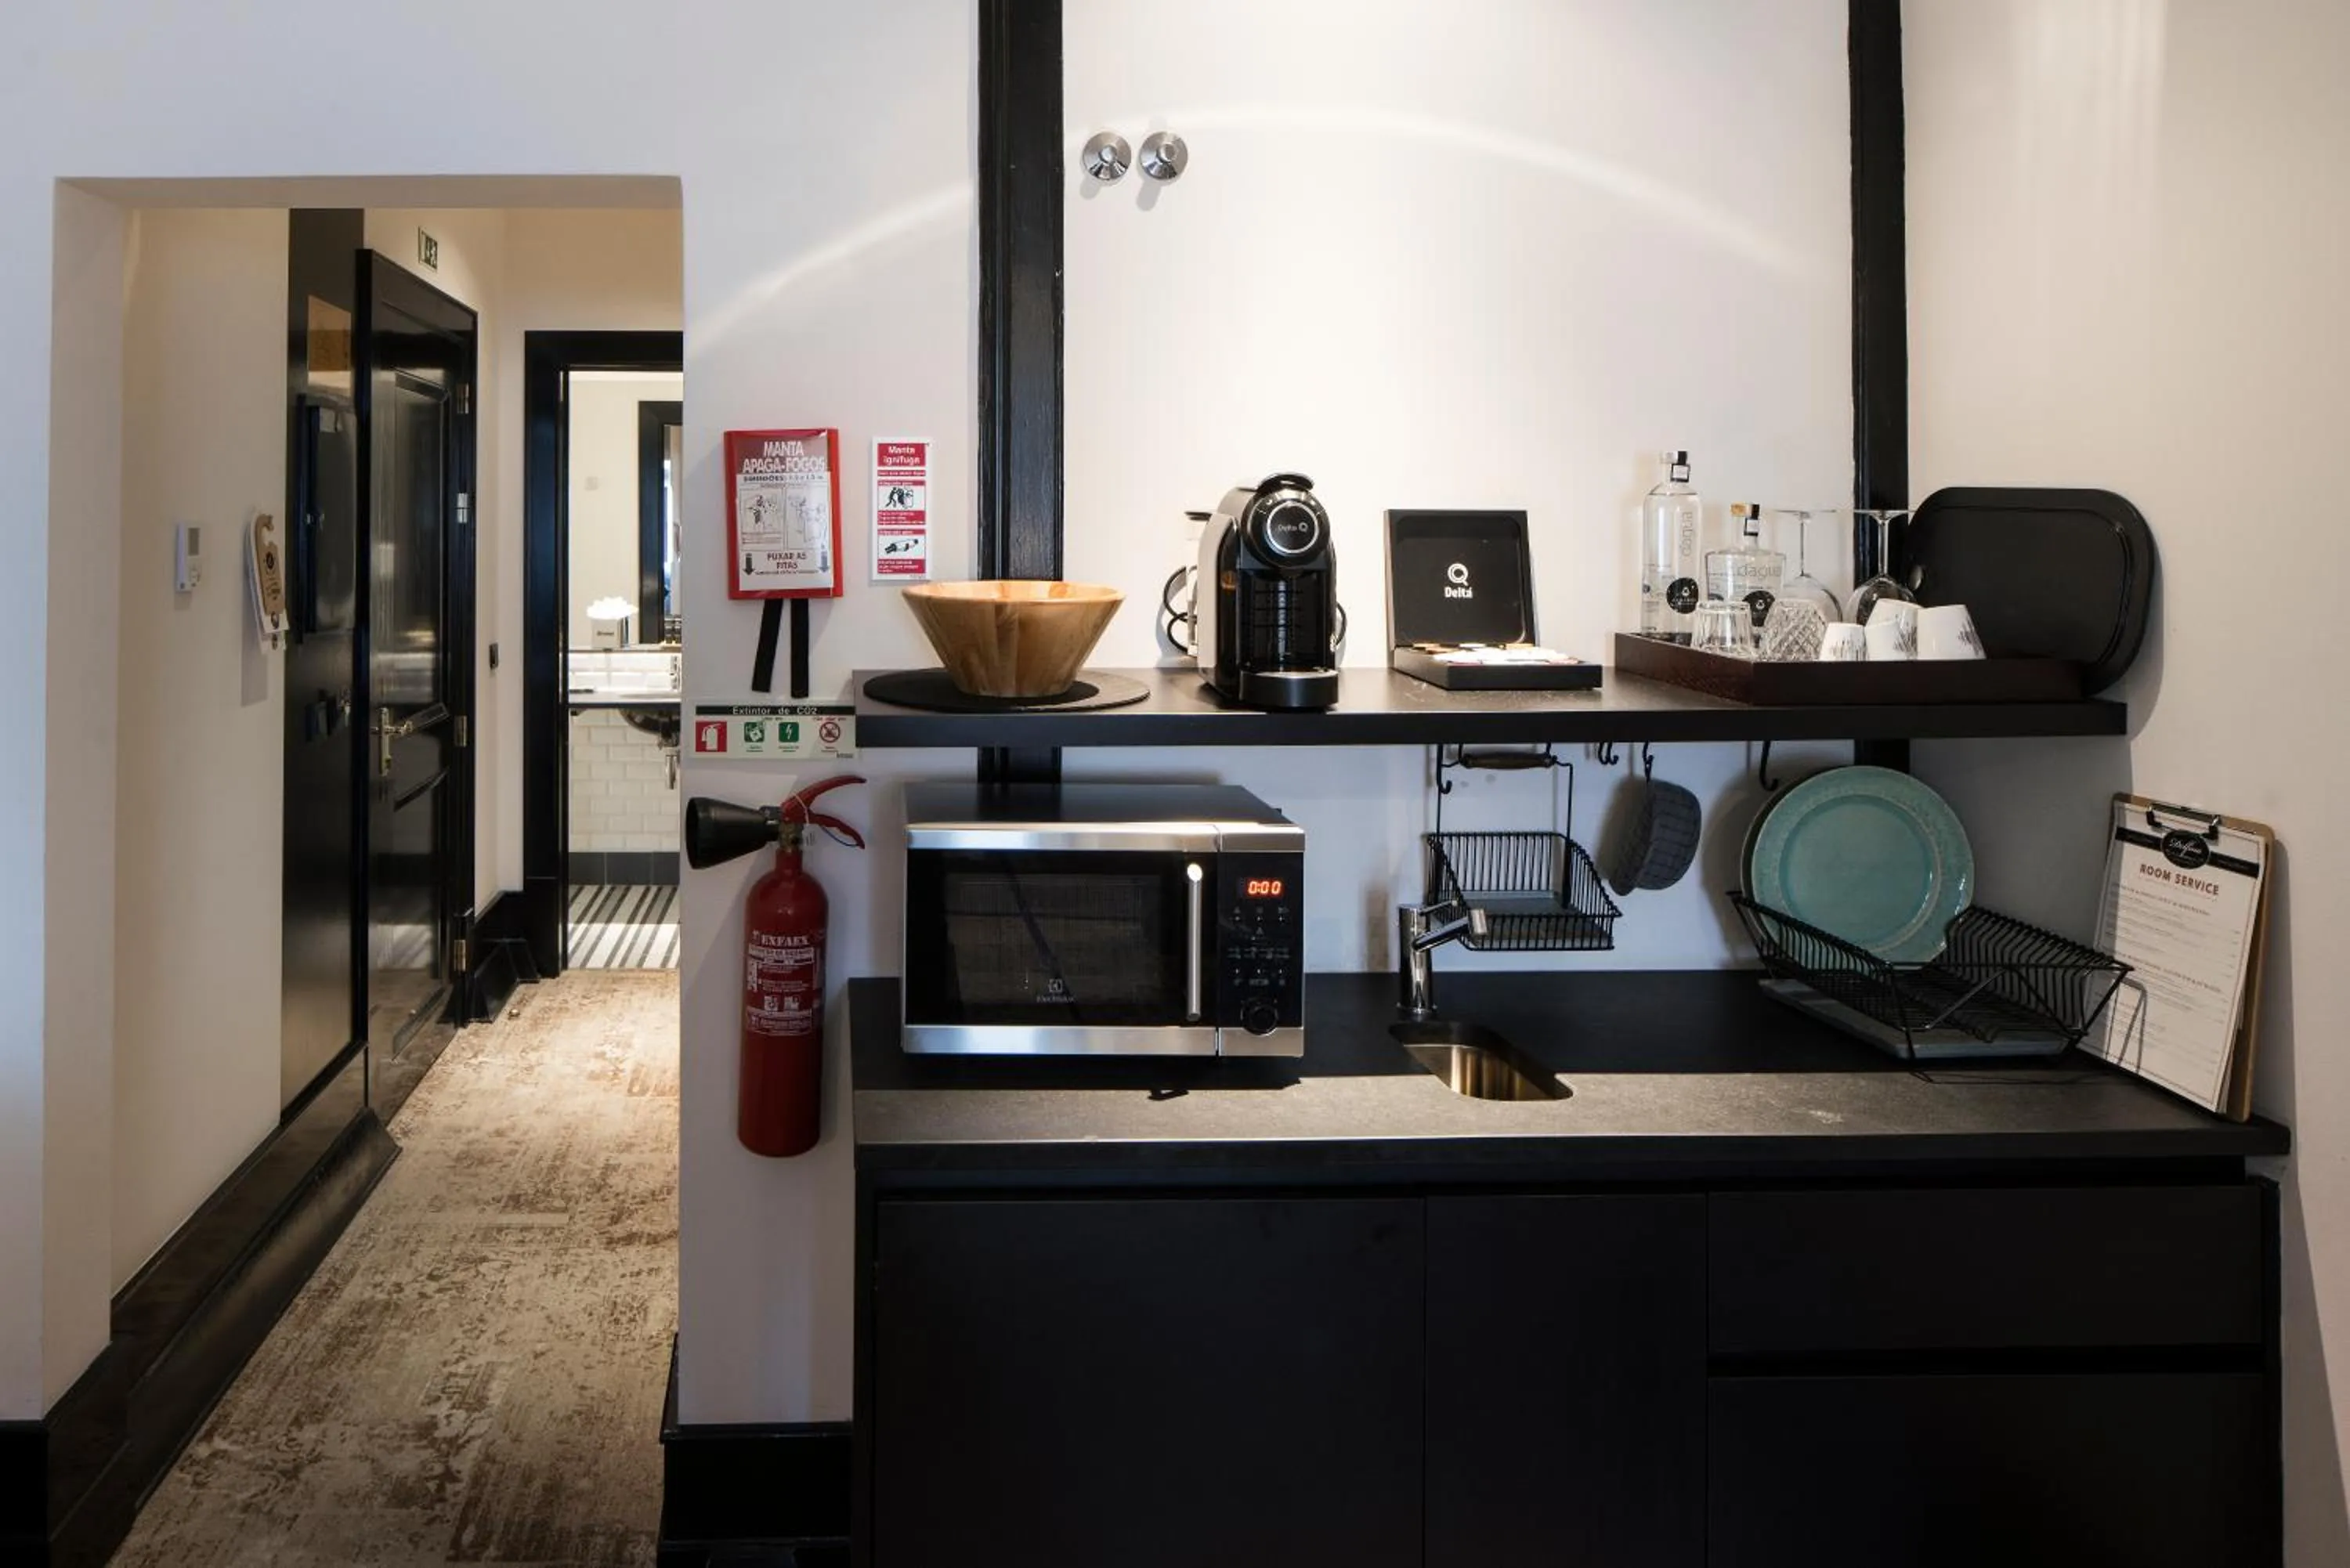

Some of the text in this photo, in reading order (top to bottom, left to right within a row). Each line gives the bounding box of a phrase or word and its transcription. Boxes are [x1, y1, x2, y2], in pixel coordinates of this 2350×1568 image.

[764, 441, 804, 457] MANTA
[742, 457, 826, 473] APAGA-FOGOS
[1448, 562, 1469, 587] Q
[1444, 586, 1473, 598] Delta
[732, 706, 818, 715] Extintor de CO2
[1248, 880, 1282, 895] 0:00
[2139, 864, 2219, 895] ROOM SERVICE
